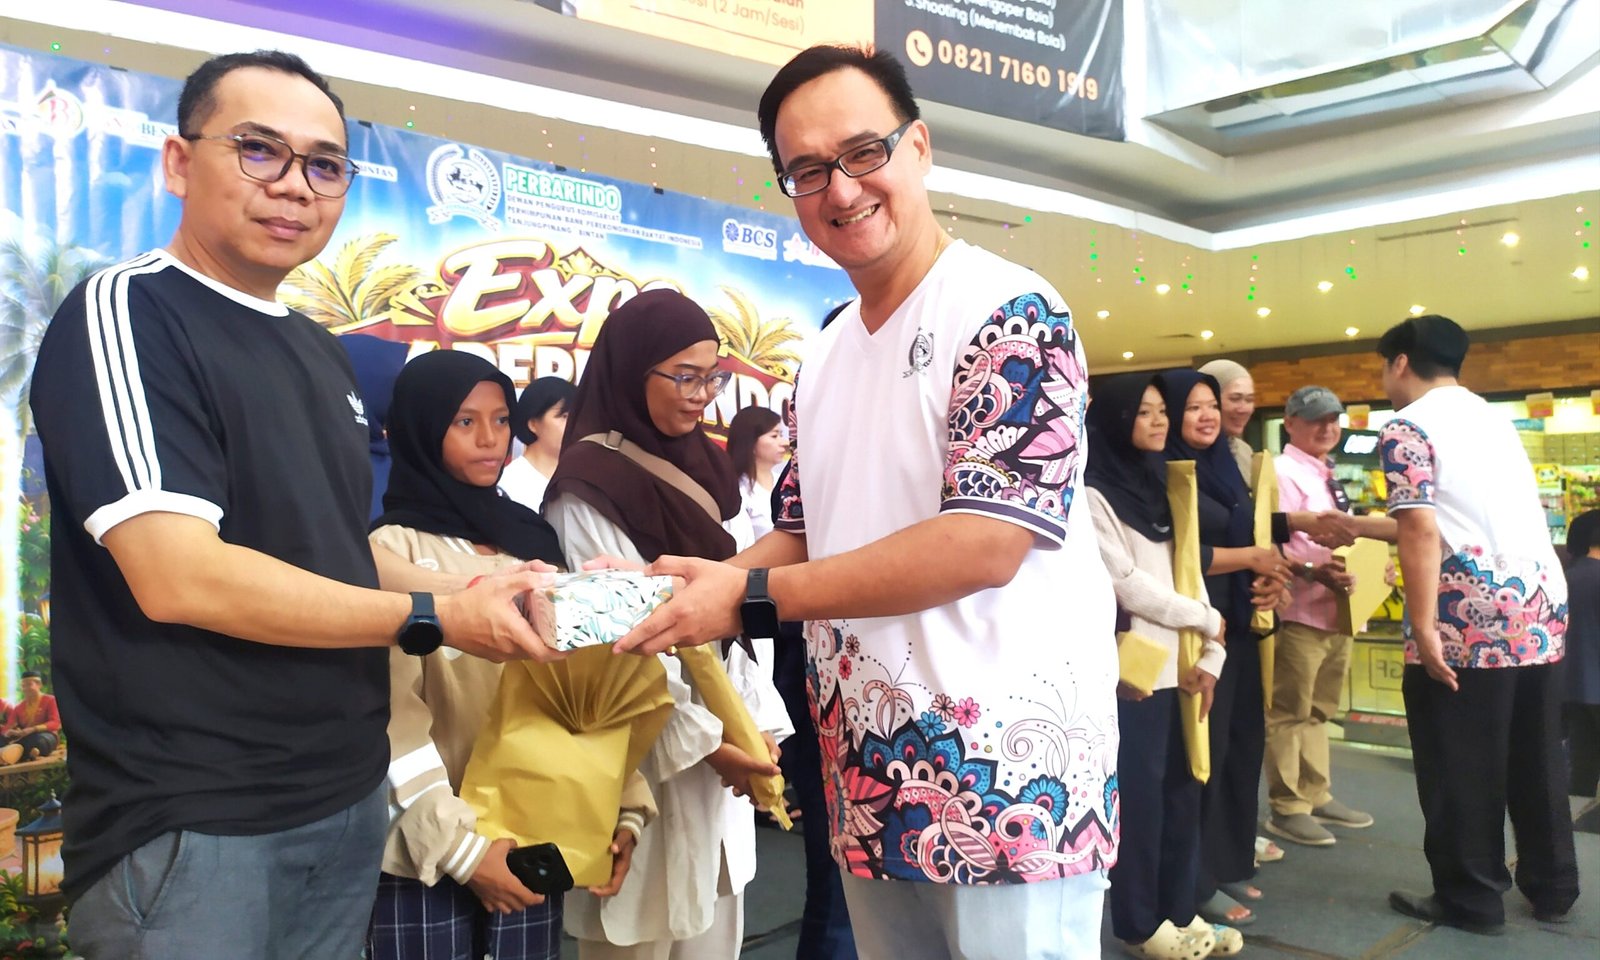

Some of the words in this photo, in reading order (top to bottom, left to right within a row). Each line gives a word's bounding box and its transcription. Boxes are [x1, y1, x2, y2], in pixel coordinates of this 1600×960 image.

[732, 3, 805, 35] Jam/Sesi)
[969, 8, 1037, 42] (Menembak
[1037, 30, 1067, 52] Bola)
[1026, 7, 1055, 29] Bola)
[937, 39, 993, 76] 0821
[999, 55, 1051, 88] 7160
[1057, 69, 1098, 100] 1919
[505, 166, 620, 211] PERBARINDO
[507, 194, 534, 206] DEWAN
[535, 200, 576, 214] PENGURUS
[507, 205, 563, 222] PERHIMPUNAN
[564, 216, 584, 226] BANK
[667, 235, 702, 247] INDONESIA
[507, 216, 573, 234] TANJUNGPINANG
[578, 230, 605, 240] BINTAN
[741, 227, 775, 248] BCS
[440, 245, 682, 346] Exp
